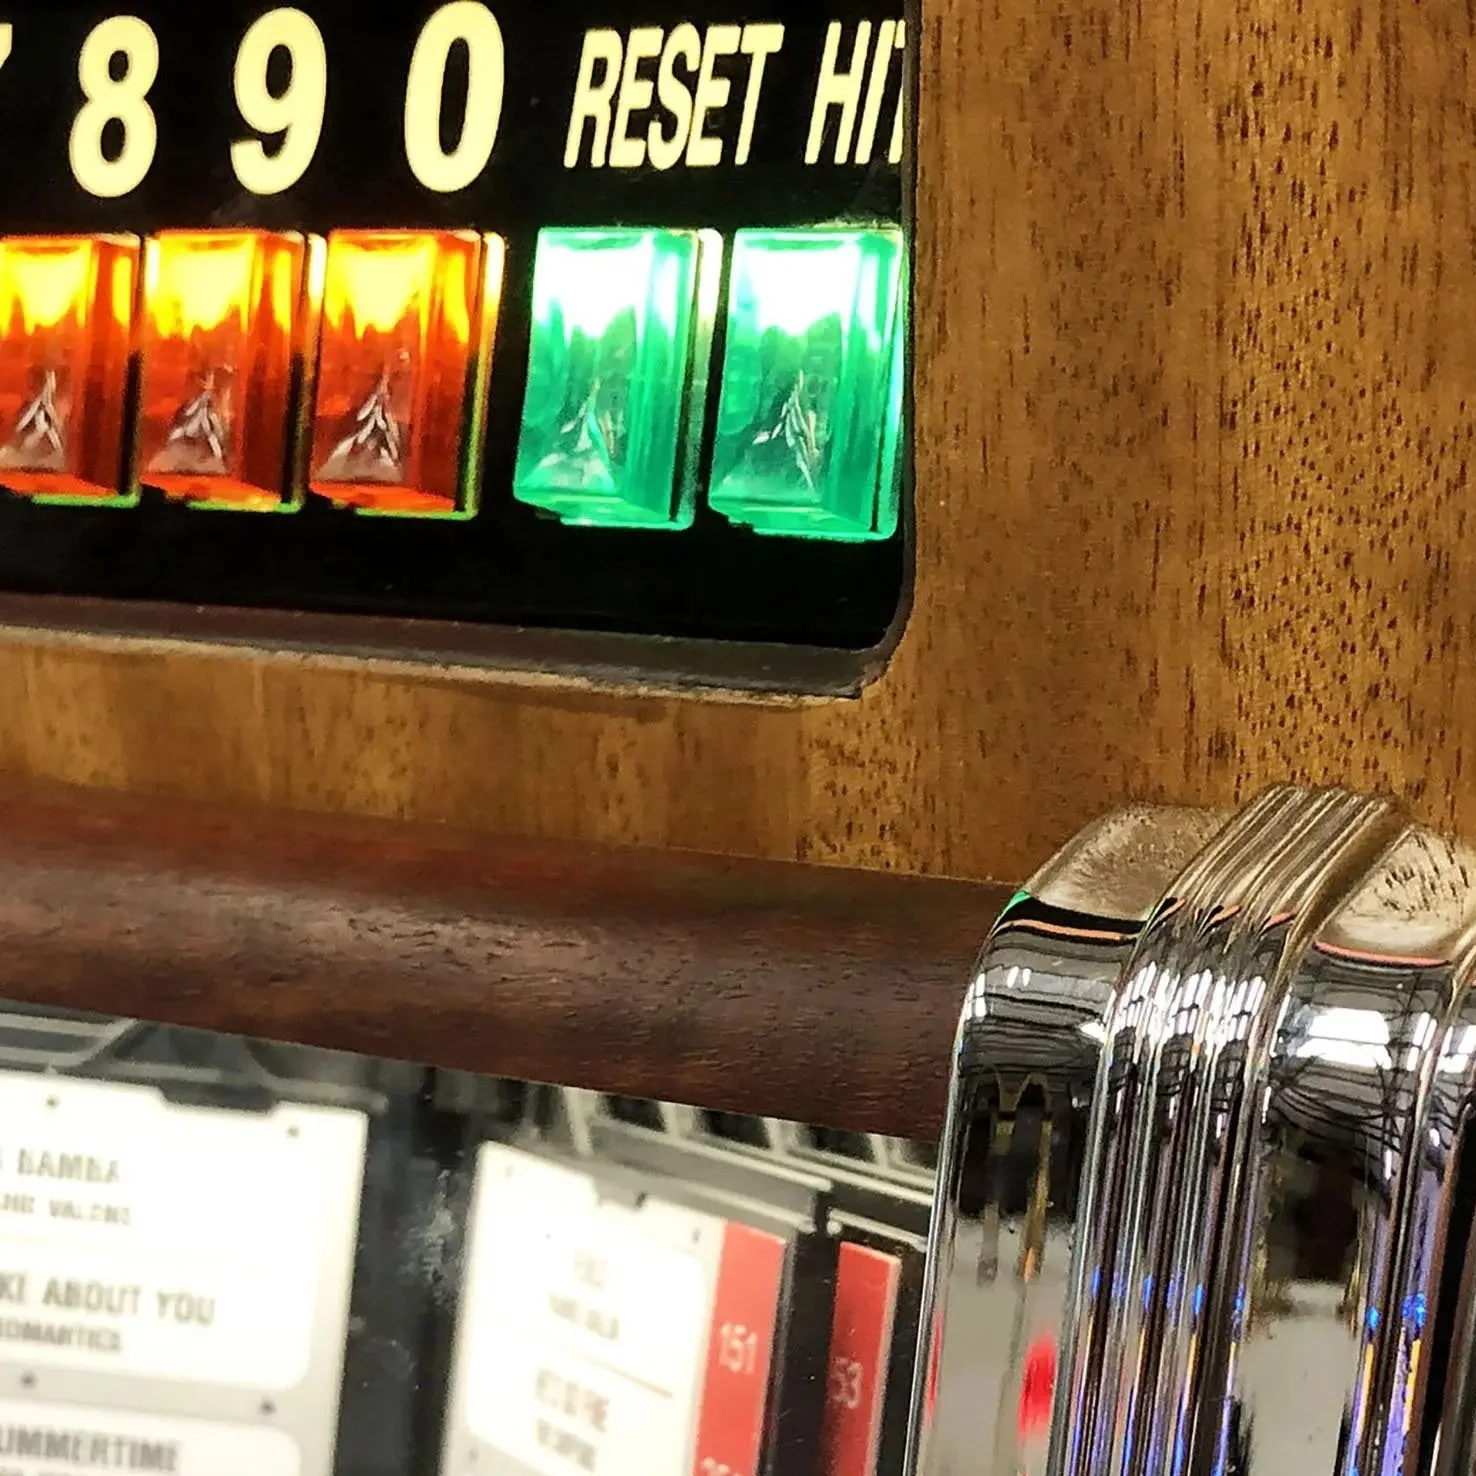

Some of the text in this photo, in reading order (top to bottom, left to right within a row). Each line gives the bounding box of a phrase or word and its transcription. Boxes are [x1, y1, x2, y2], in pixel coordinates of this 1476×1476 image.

[69, 15, 160, 199] 8
[230, 7, 327, 197] 9
[404, 1, 505, 194] 0
[564, 23, 785, 171] RESET
[42, 1276, 142, 1316] ABOUT
[156, 1291, 216, 1328] YOU
[719, 1323, 758, 1375] 151
